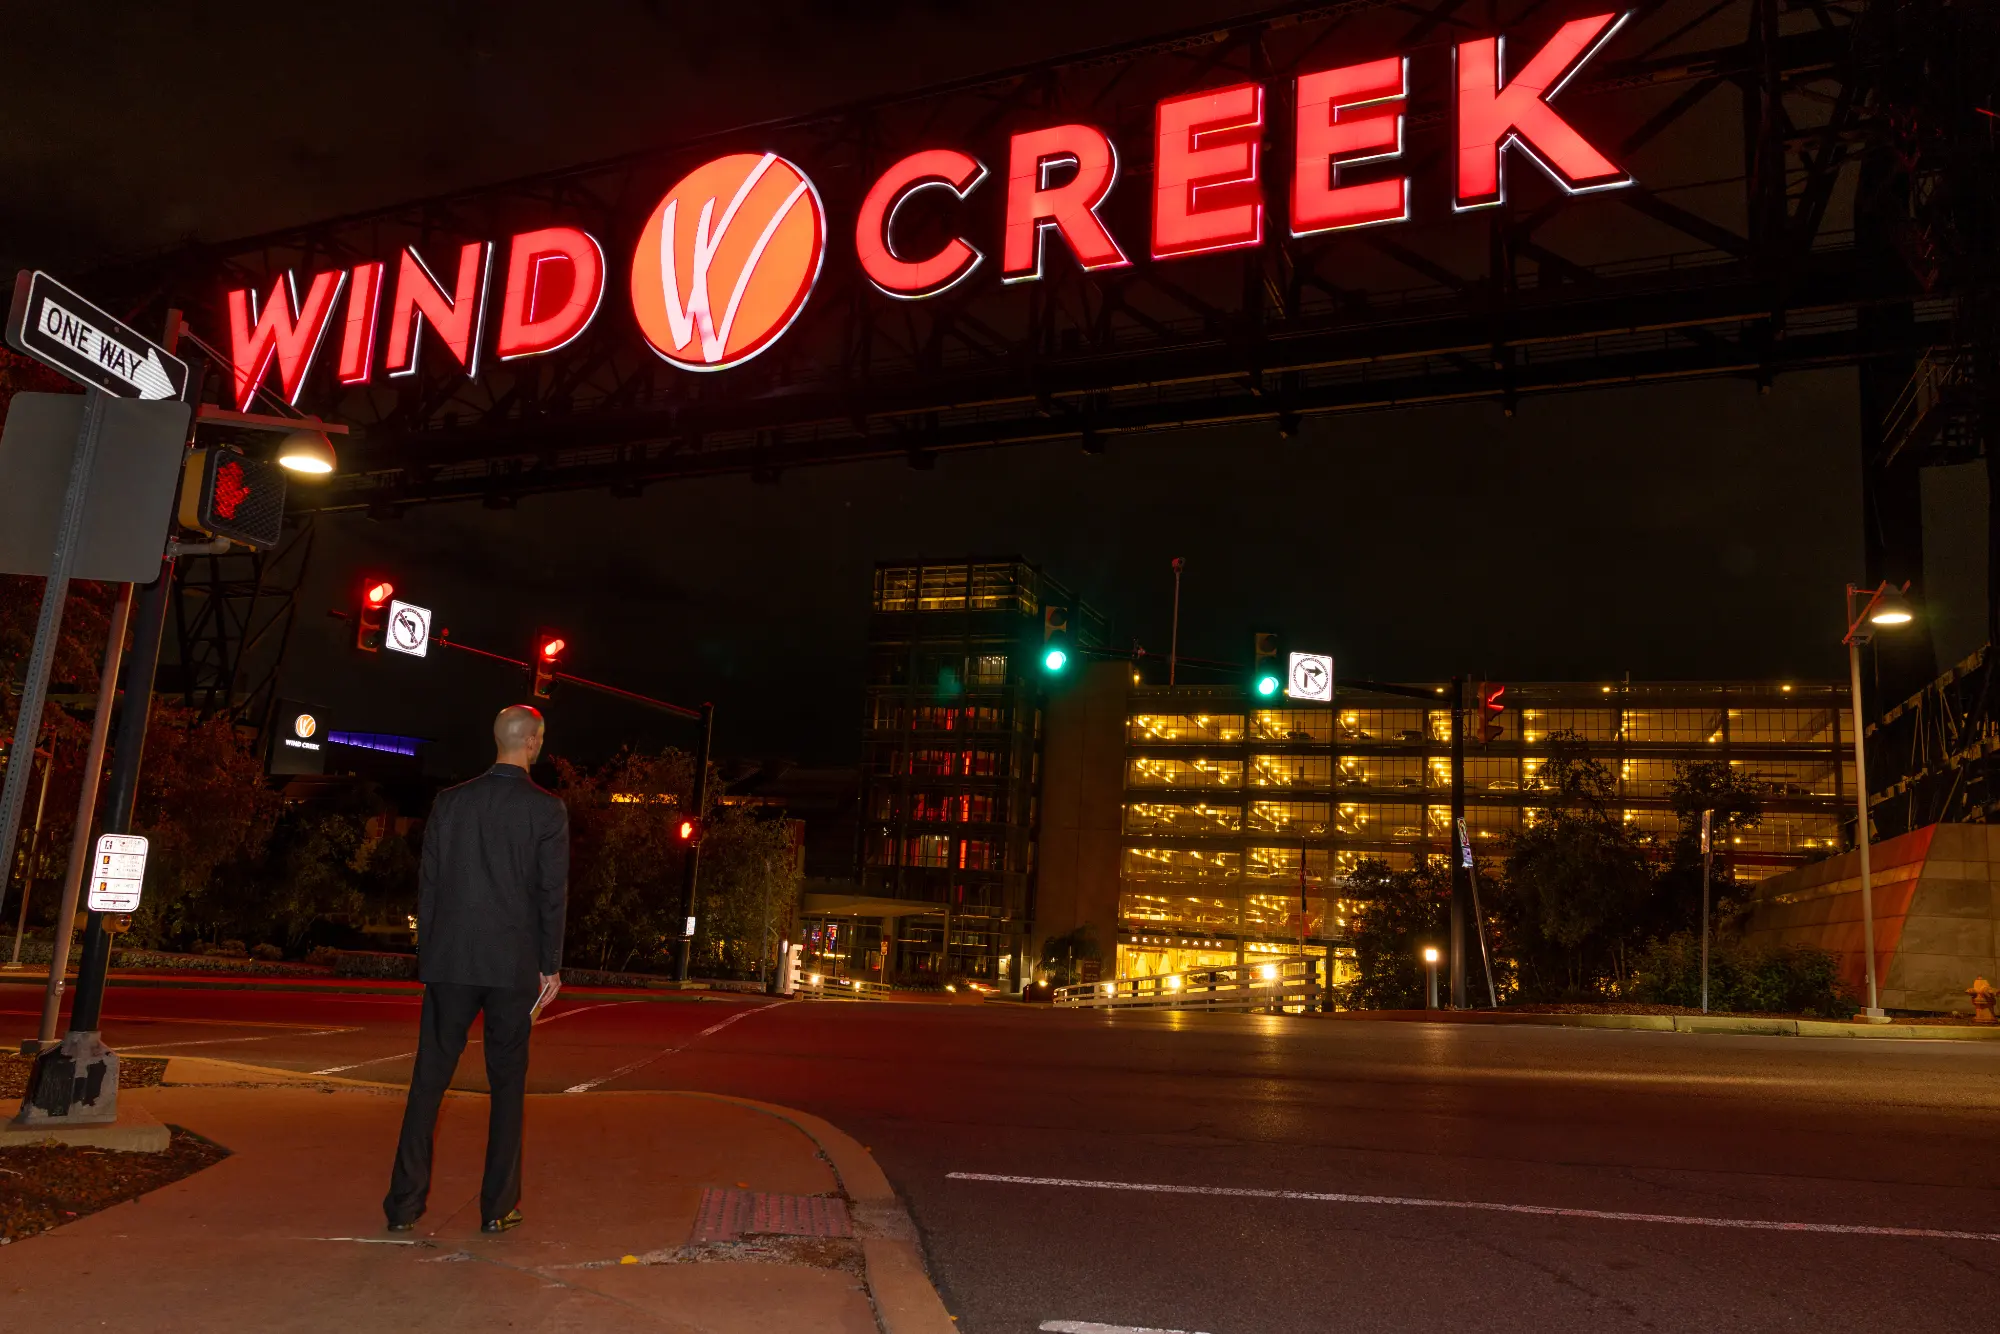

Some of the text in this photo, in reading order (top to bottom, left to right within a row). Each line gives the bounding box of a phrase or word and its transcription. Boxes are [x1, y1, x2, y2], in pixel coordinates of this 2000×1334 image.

[228, 8, 1637, 414] WIND CREEK
[47, 308, 142, 381] ONE WAY
[286, 739, 319, 750] WIND CREEK
[1131, 936, 1222, 947] SELF PARK
